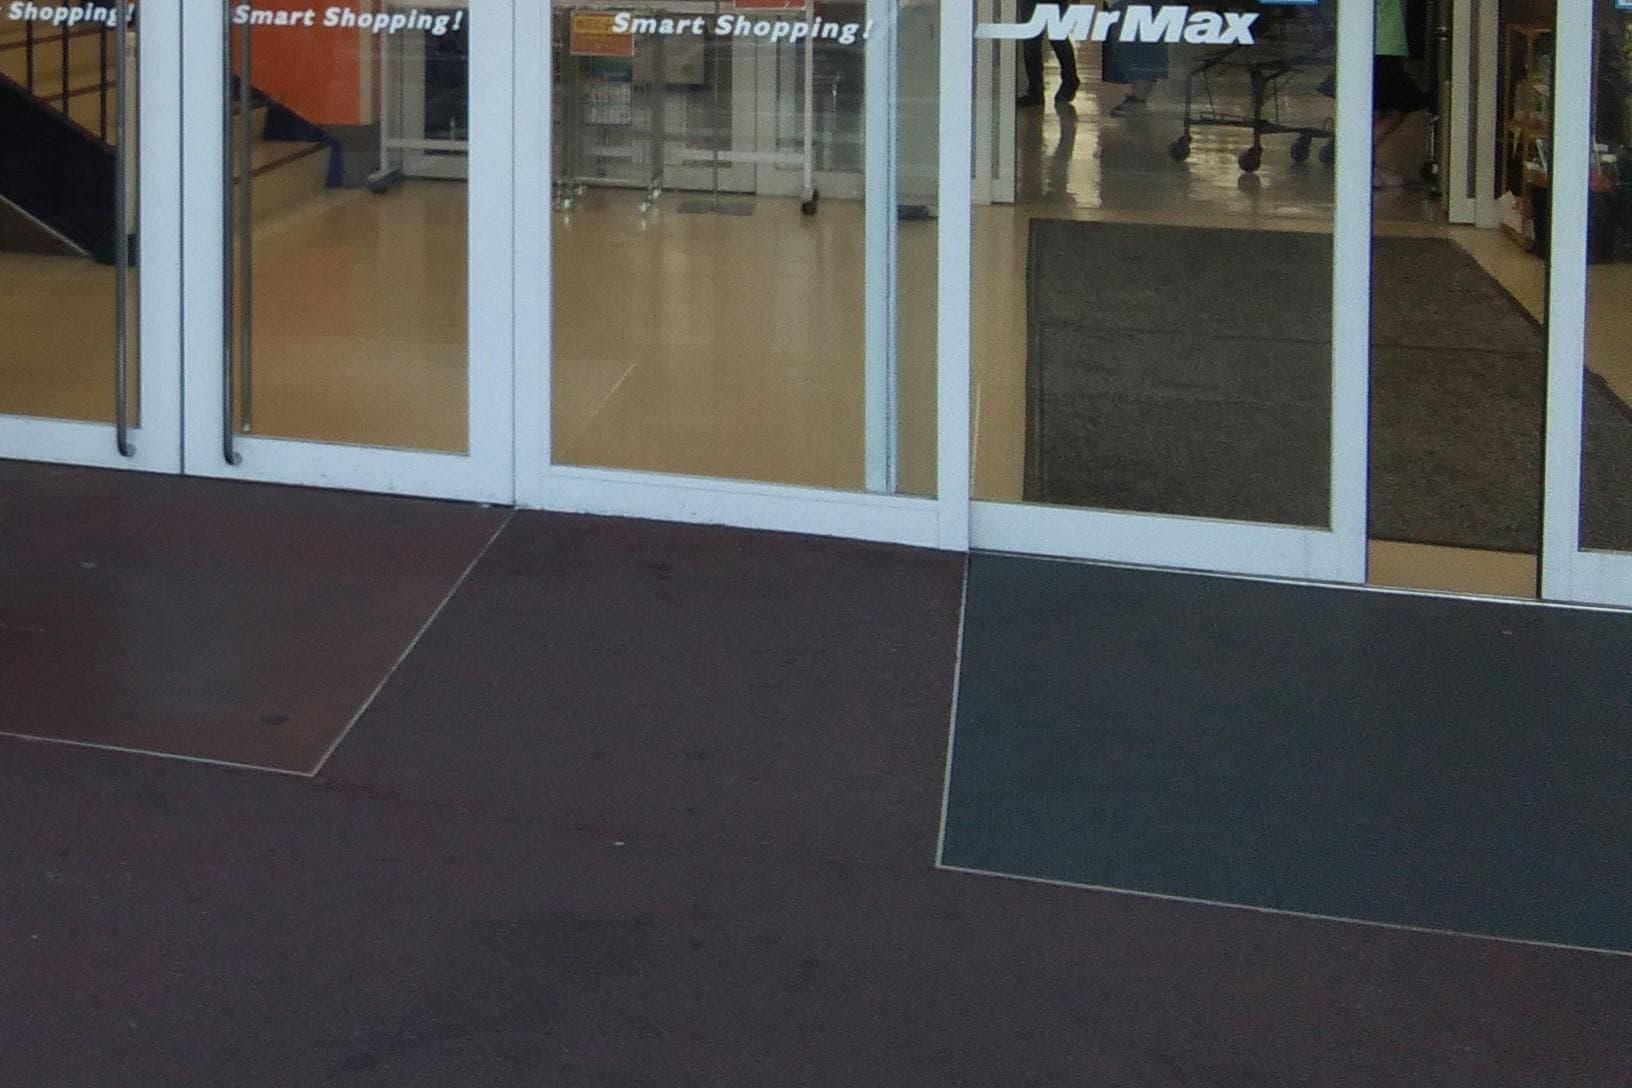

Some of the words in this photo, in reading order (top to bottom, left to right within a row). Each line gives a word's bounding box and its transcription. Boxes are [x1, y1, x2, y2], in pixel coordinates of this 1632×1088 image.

[9, 2, 135, 29] Shopping!
[232, 4, 314, 28] Smart
[323, 7, 463, 36] Shopping!
[612, 12, 705, 39] Smart
[715, 14, 874, 46] Shopping!
[974, 3, 1260, 45] MrMax
